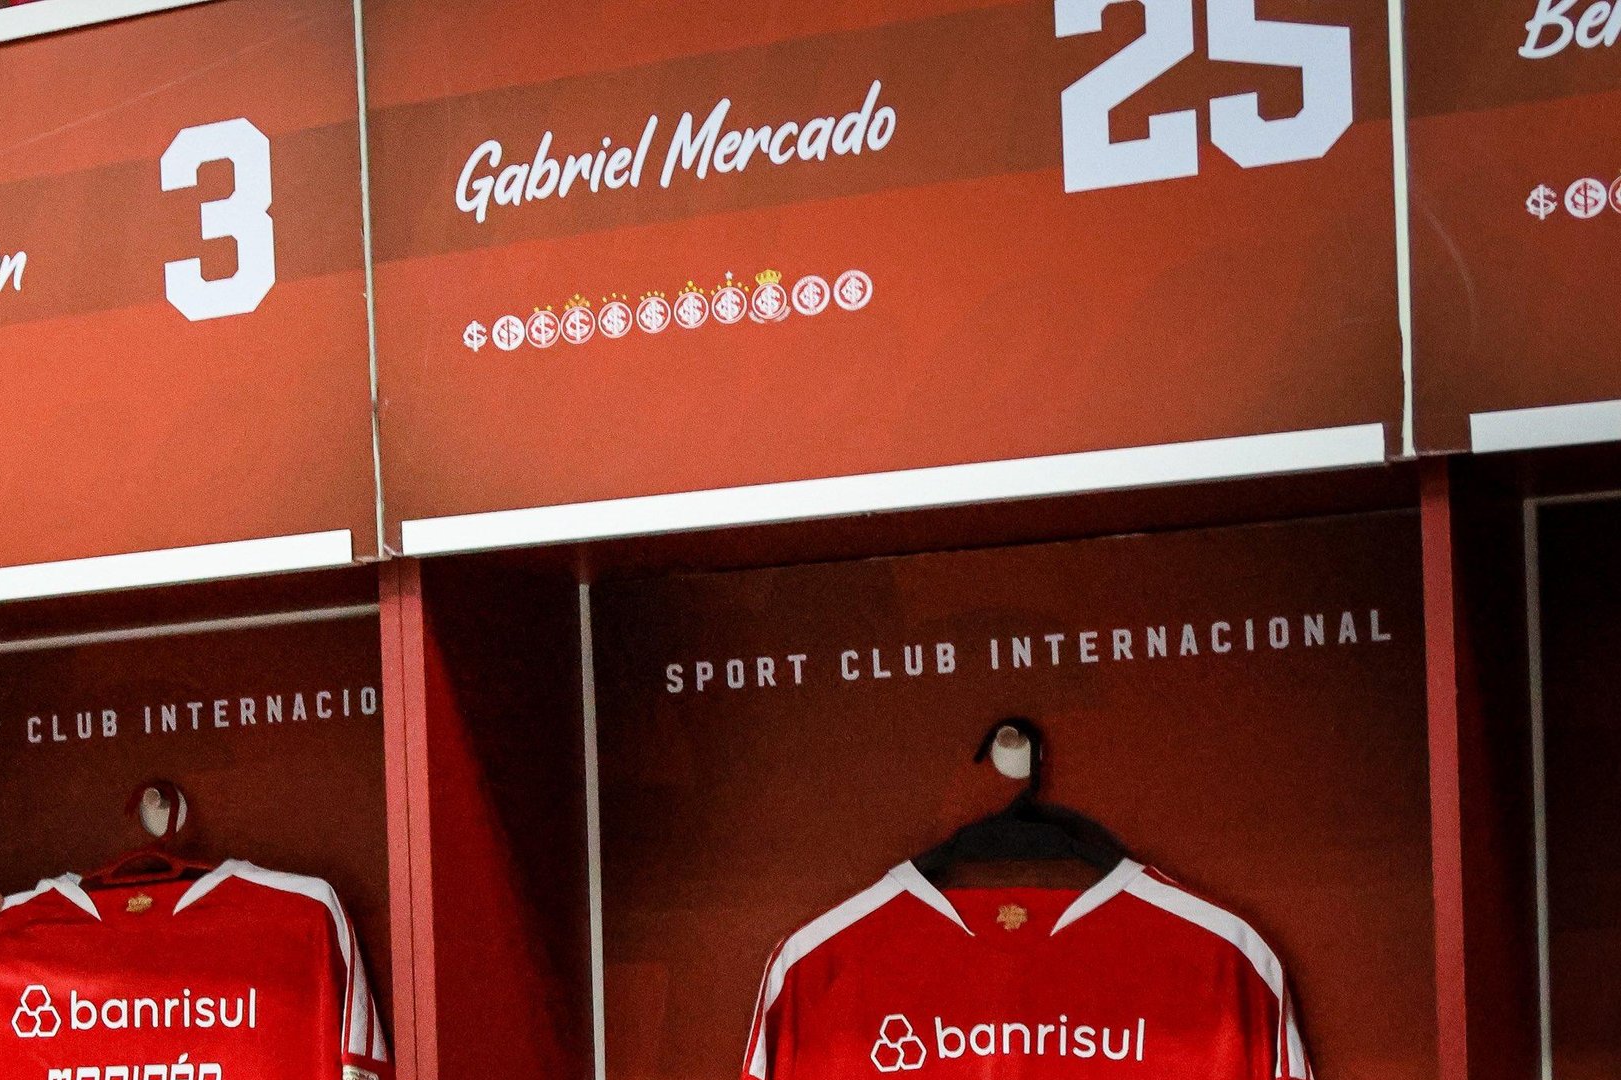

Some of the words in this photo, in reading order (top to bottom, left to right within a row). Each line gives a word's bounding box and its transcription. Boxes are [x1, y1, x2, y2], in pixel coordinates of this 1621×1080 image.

[1054, 0, 1353, 193] 25
[455, 114, 659, 224] Gabriel
[659, 79, 897, 189] Mercado
[160, 117, 275, 322] 3
[666, 653, 807, 694] SPORT
[840, 642, 956, 681] CLUB
[990, 609, 1392, 670] INTERNACIONAL
[27, 709, 118, 744] CLUB
[144, 686, 377, 734] INTERNACIO
[70, 987, 256, 1030] banrisul
[934, 1014, 1145, 1061] banrisul
